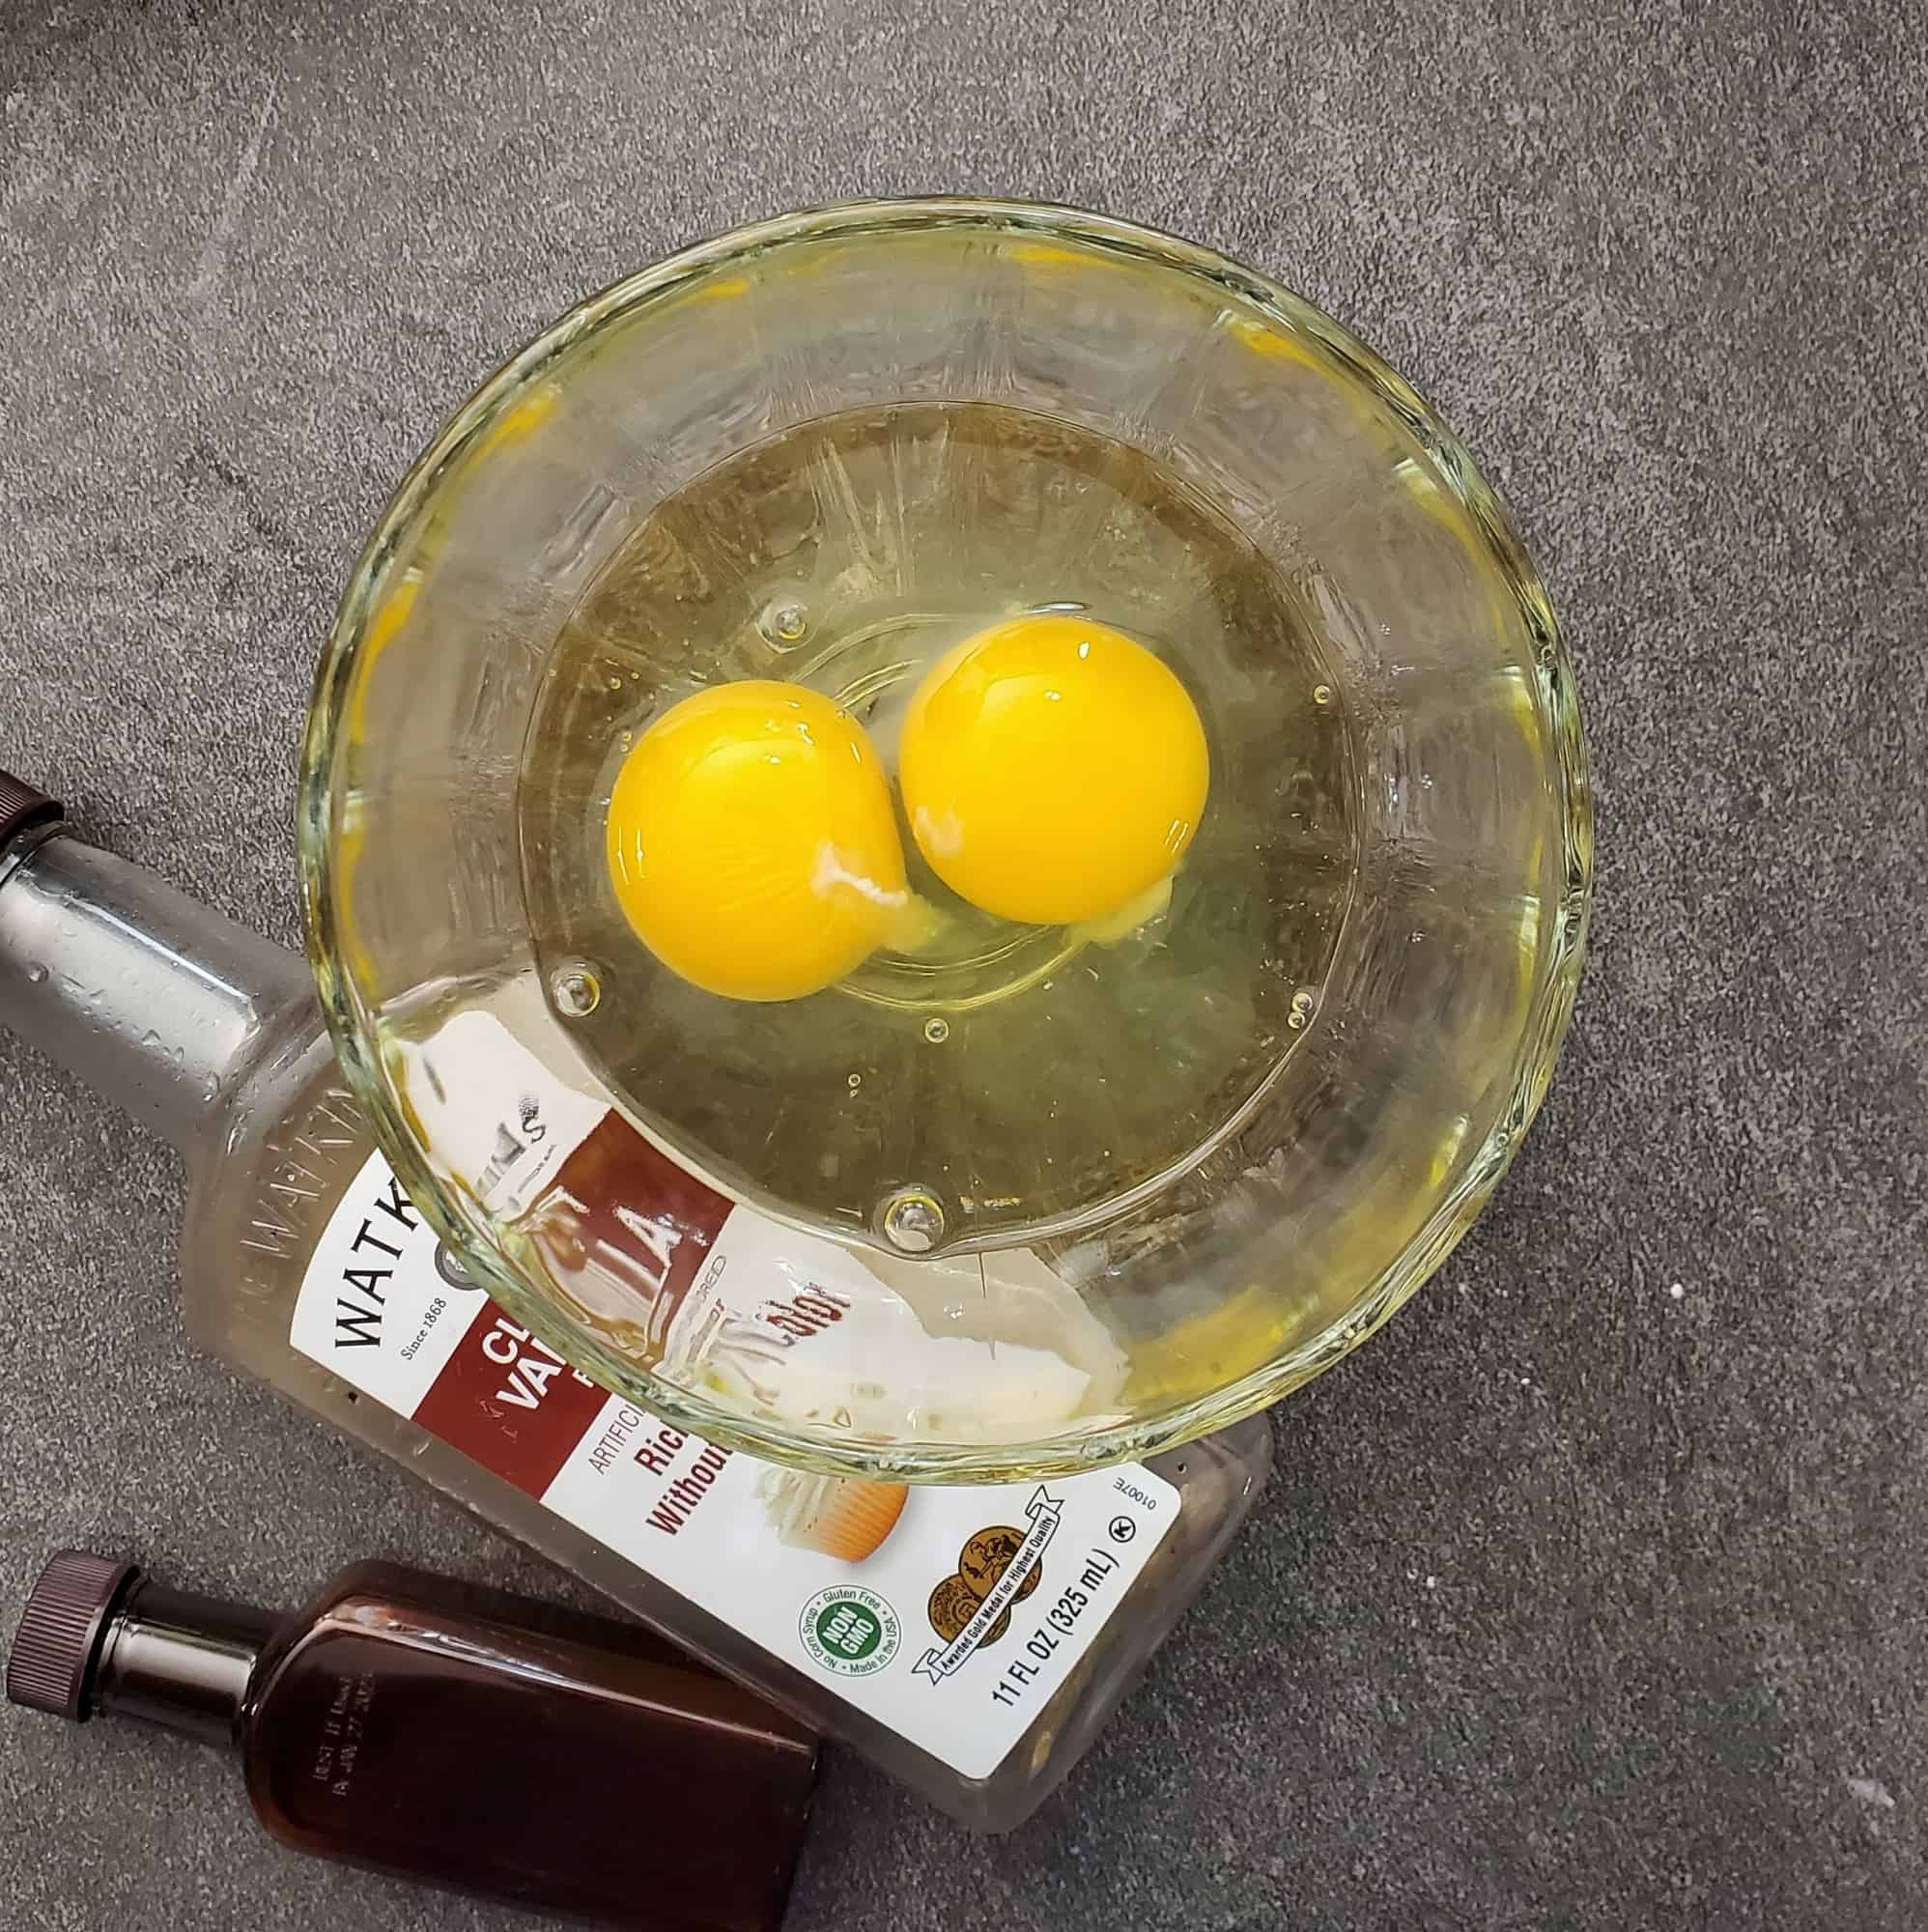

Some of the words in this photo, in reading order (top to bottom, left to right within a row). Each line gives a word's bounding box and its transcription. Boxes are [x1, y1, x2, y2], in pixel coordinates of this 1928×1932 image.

[401, 1328, 428, 1360] Since
[424, 1297, 447, 1328] 1868
[587, 1404, 647, 1475] ARTIFICI
[1113, 1477, 1157, 1511] 01007E
[822, 1588, 857, 1603] Gluten
[859, 1591, 881, 1609] Free
[941, 1634, 973, 1670] Awarded
[967, 1619, 986, 1638] Gold
[981, 1592, 1006, 1621] Medal
[1000, 1580, 1014, 1595] for
[1007, 1548, 1036, 1582] Highest
[1029, 1516, 1056, 1548] Quality
[803, 1607, 818, 1634] Syrup
[822, 1605, 858, 1644] NON
[840, 1618, 874, 1654] GMO
[992, 1681, 1021, 1706] 11
[1007, 1660, 1039, 1686] FL
[1027, 1629, 1059, 1661] OZ
[1045, 1587, 1088, 1635] (325
[1080, 1548, 1120, 1591] mL)
[807, 1636, 824, 1658] Corn
[823, 1655, 837, 1669] No
[850, 1661, 878, 1673] Made
[884, 1616, 897, 1637] USA
